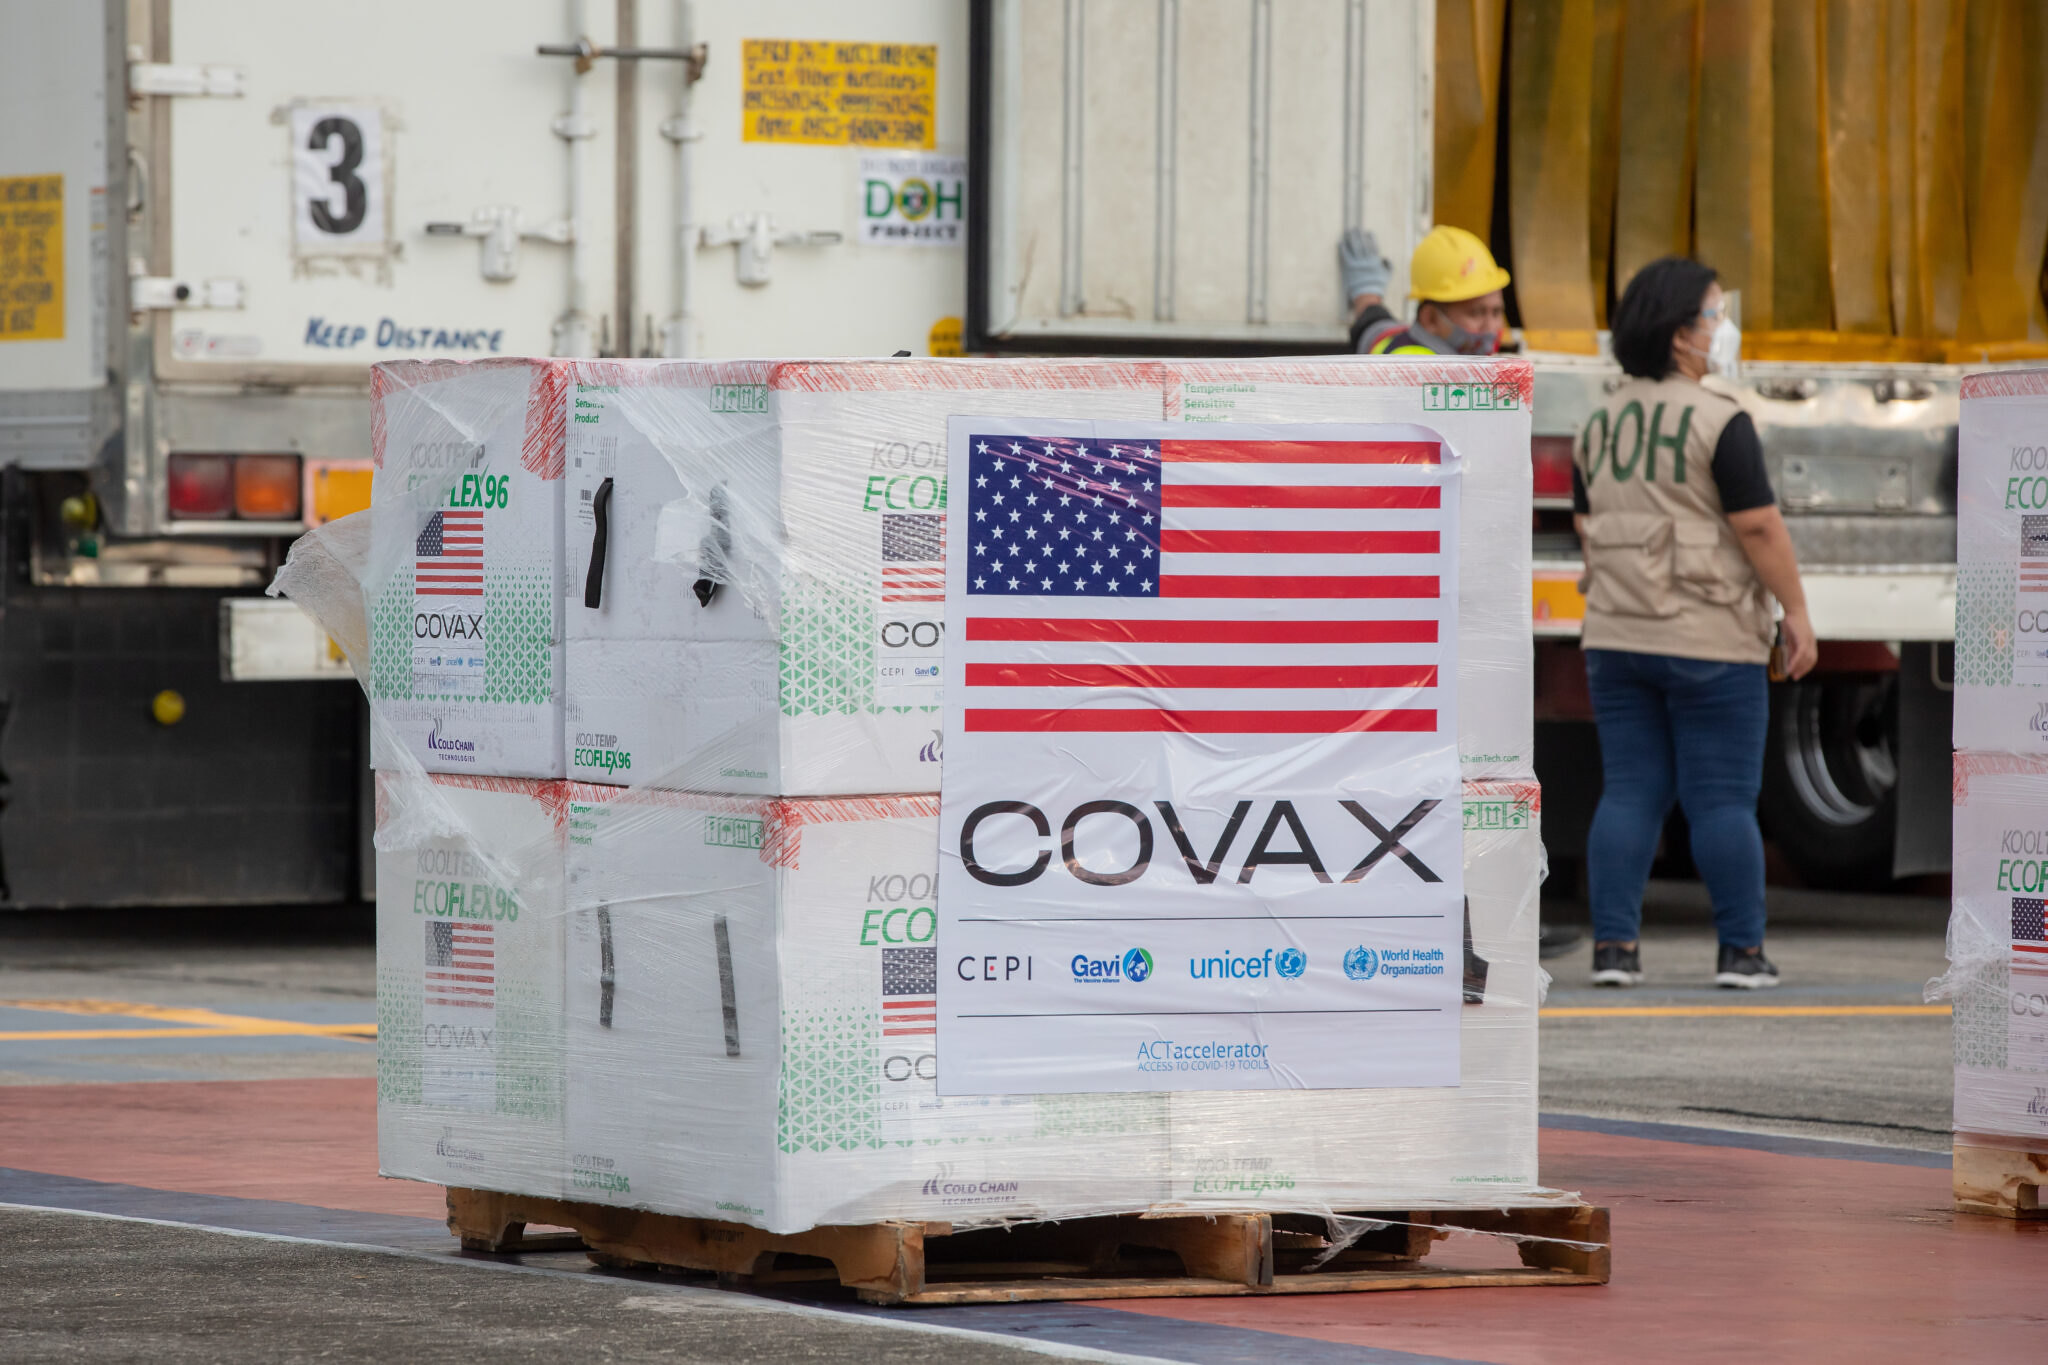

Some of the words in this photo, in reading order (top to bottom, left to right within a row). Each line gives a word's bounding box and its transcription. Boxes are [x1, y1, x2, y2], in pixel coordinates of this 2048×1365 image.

[308, 116, 367, 234] 3
[866, 178, 962, 221] DOH
[305, 317, 366, 348] KEEP
[376, 317, 504, 351] DISTANCE
[1184, 383, 1257, 395] Temperature
[1184, 398, 1236, 408] Sensitive
[575, 413, 599, 424] Product
[414, 613, 483, 640] COVAX
[881, 621, 945, 648] CO
[881, 667, 904, 677] CEPI
[438, 738, 454, 750] COLD
[455, 739, 474, 751] CHAIN
[576, 732, 618, 747] KOOLTEMP
[438, 754, 476, 762] TECHNOLOGIES
[574, 747, 631, 775] ECOFLEX96
[960, 799, 1444, 887] COVAX
[2001, 830, 2048, 855] KOOL
[413, 880, 520, 922] ECOFLEX96
[859, 907, 937, 946] ECO
[1190, 949, 1273, 979] unicef
[1381, 949, 1410, 961] World
[1412, 948, 1444, 961] Health
[957, 956, 1032, 981] CEPI
[1071, 954, 1120, 977] Gavi
[1380, 963, 1444, 977] Organization
[1137, 1041, 1269, 1060] ACTaccelerator
[1138, 1061, 1173, 1072] ACCESS
[1176, 1060, 1189, 1071] TO
[1191, 1060, 1236, 1071] COVID-19
[1238, 1059, 1270, 1071] TOOLS
[942, 1183, 978, 1195] COLD
[979, 1182, 1018, 1194] CHAIN
[942, 1196, 1017, 1205] TECHNOLOGIES
